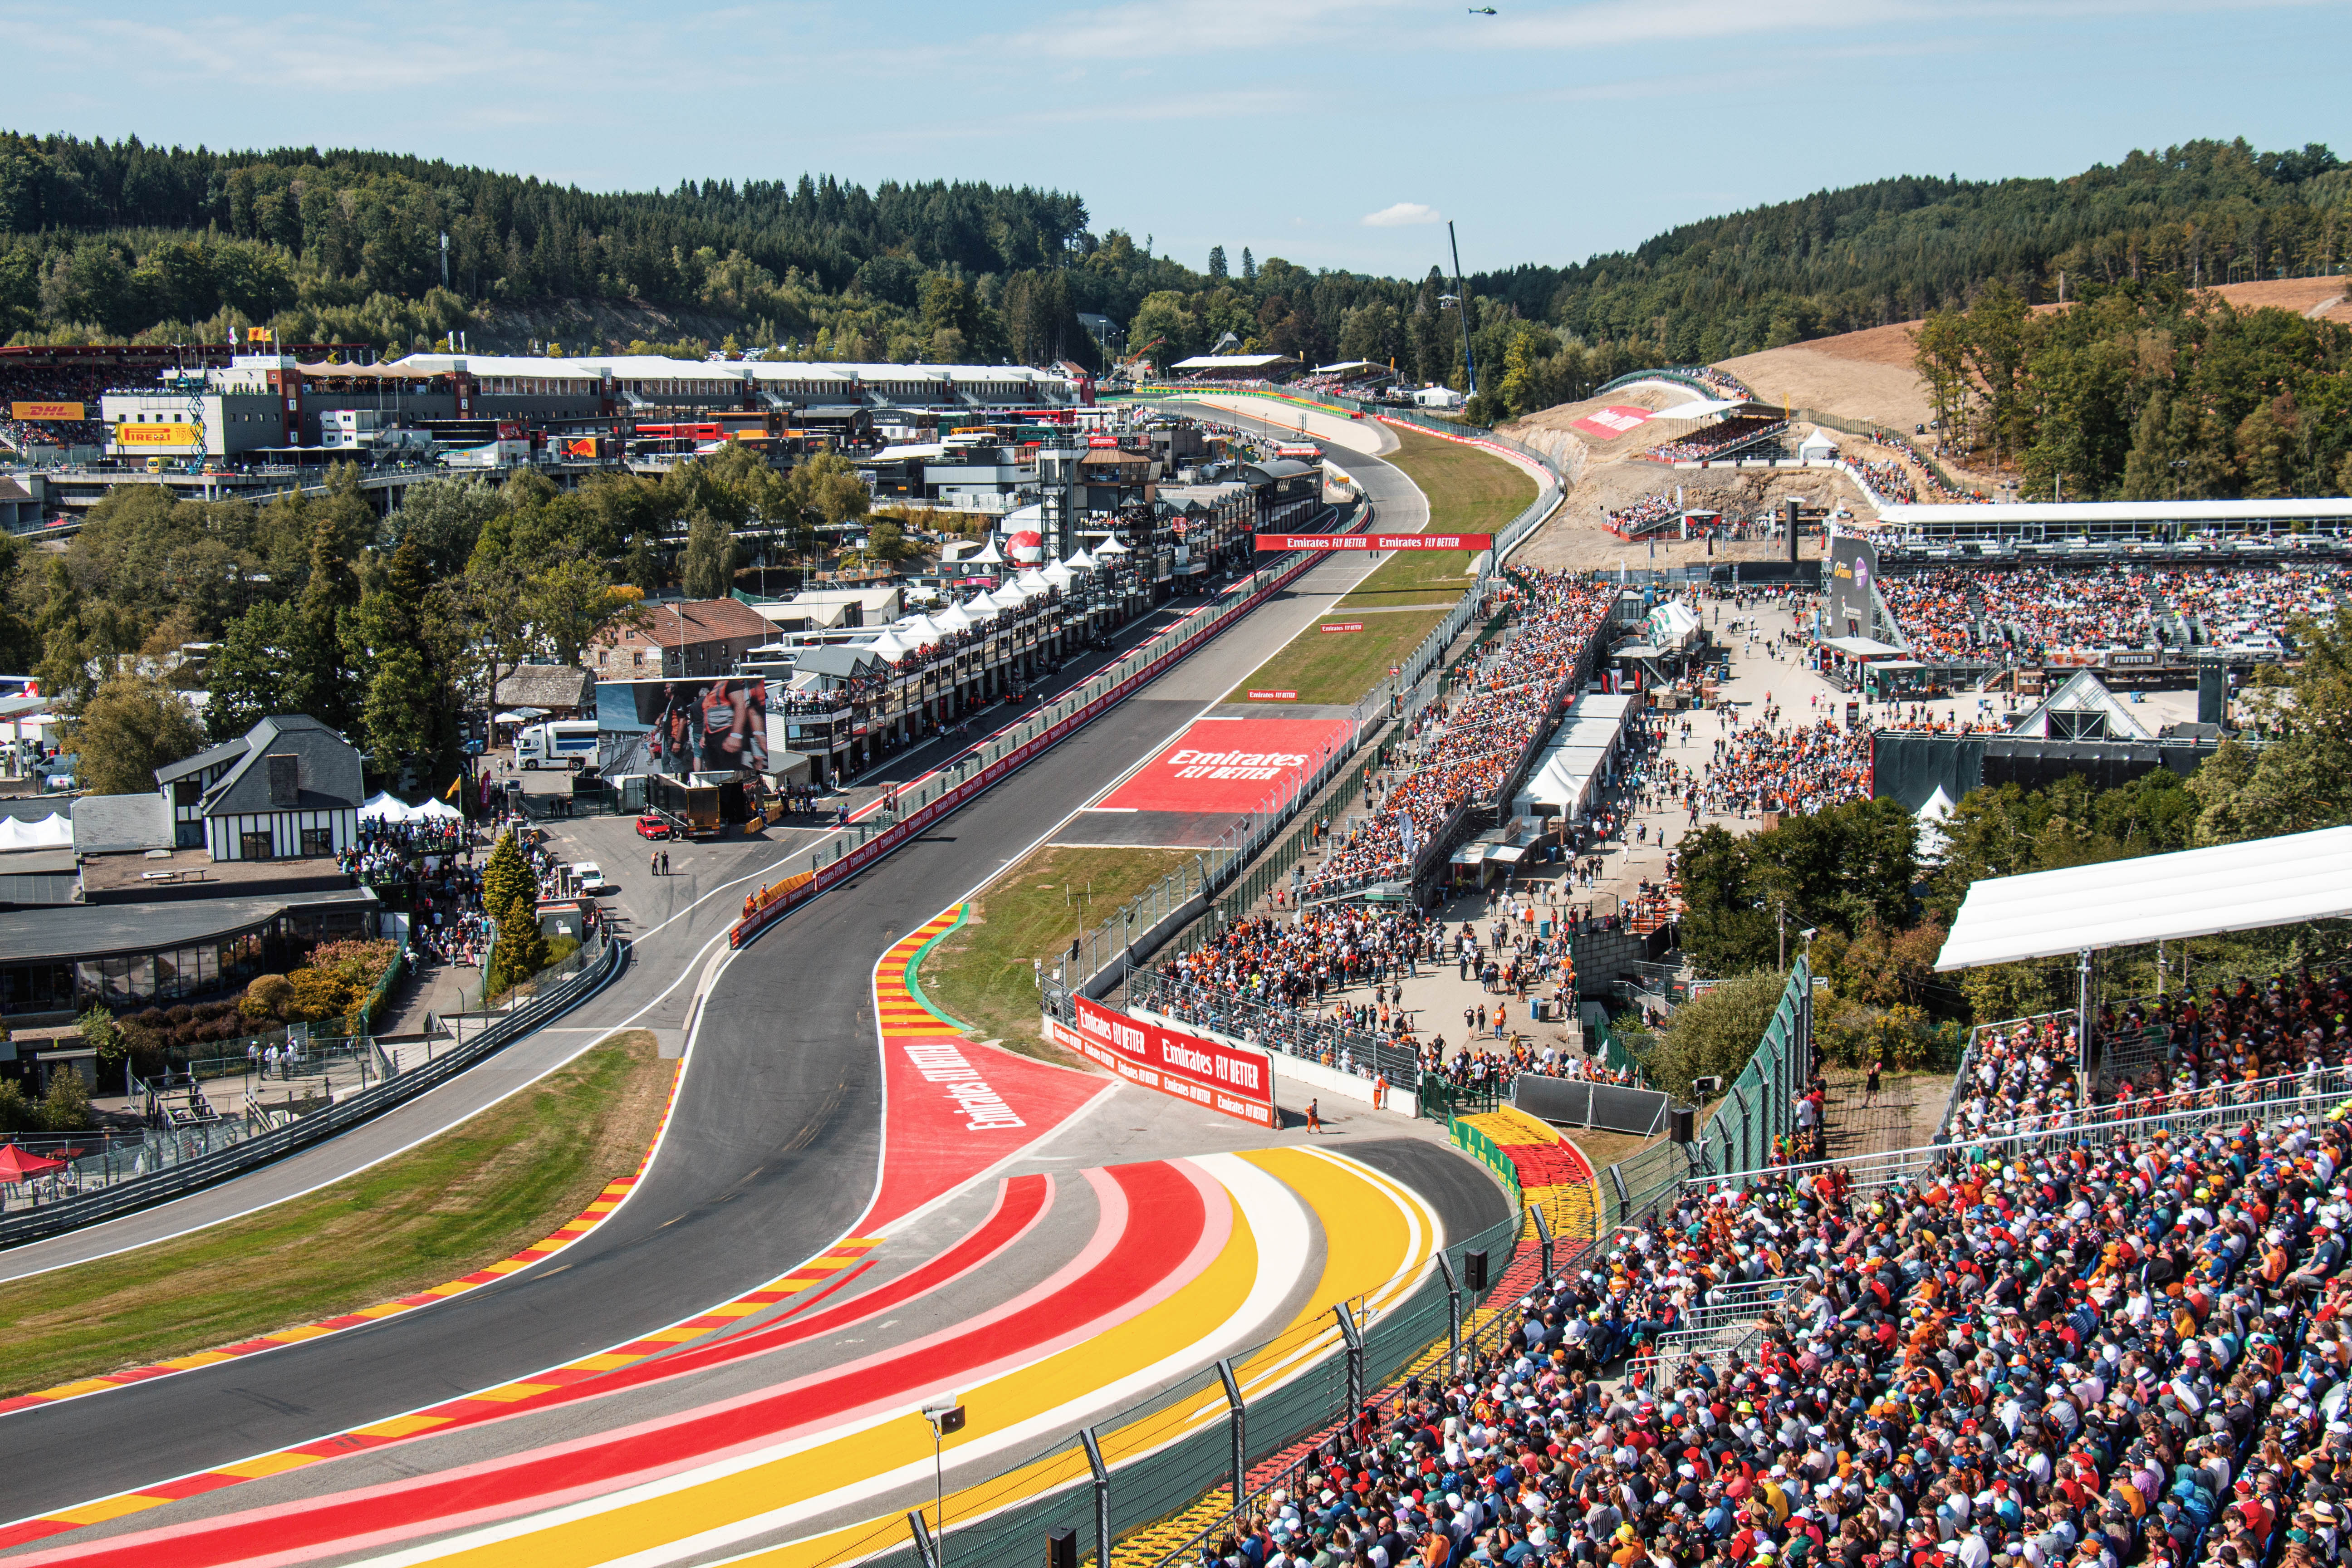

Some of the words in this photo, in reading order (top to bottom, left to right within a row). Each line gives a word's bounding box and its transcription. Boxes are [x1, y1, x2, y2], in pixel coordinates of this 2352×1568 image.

[29, 406, 69, 416] DHL
[291, 401, 294, 409] 1
[463, 400, 466, 408] 2
[124, 428, 171, 441] PIRELLI
[293, 433, 296, 442] 1
[1287, 538, 1329, 547] Emirates
[1333, 538, 1343, 547] FLY
[1344, 538, 1367, 547] BETTER
[1379, 538, 1421, 547] Emirates
[1425, 538, 1436, 547] FLY
[1437, 538, 1460, 547] BETTER
[2114, 655, 2153, 663] FRITUUR
[1168, 750, 1308, 770] Emirates
[1174, 765, 1216, 778] FLY
[1208, 766, 1281, 780] BETTER
[935, 799, 948, 813] Emirates
[909, 818, 921, 830] Emirates
[880, 834, 894, 848] Emirates
[850, 851, 865, 867] Emirates
[818, 870, 834, 887] Emirates
[839, 860, 847, 875] BETTER
[789, 889, 802, 902] Emirates
[763, 905, 775, 920] Emirates
[740, 922, 751, 936] Emirates
[1054, 1026, 1069, 1043] Emirates
[1079, 1006, 1112, 1040] Emirates
[1112, 1022, 1122, 1046] FLY
[1122, 1026, 1145, 1054] BETTER
[903, 1044, 971, 1069] BETTER
[1085, 1042, 1101, 1060] Emirates
[1105, 1052, 1114, 1069] BETTER
[1162, 1038, 1213, 1075] Emirates
[1216, 1055, 1228, 1081] FLY
[1230, 1059, 1259, 1090] BETTER
[921, 1069, 982, 1082] FLY
[1118, 1060, 1138, 1080] Emirates
[1145, 1071, 1158, 1086] BETTER
[1164, 1076, 1189, 1097] Emirates
[1197, 1088, 1211, 1104] BETTER
[943, 1082, 1027, 1131] Emirates
[1217, 1094, 1245, 1115] Emirates
[1253, 1105, 1268, 1122] BETTER
